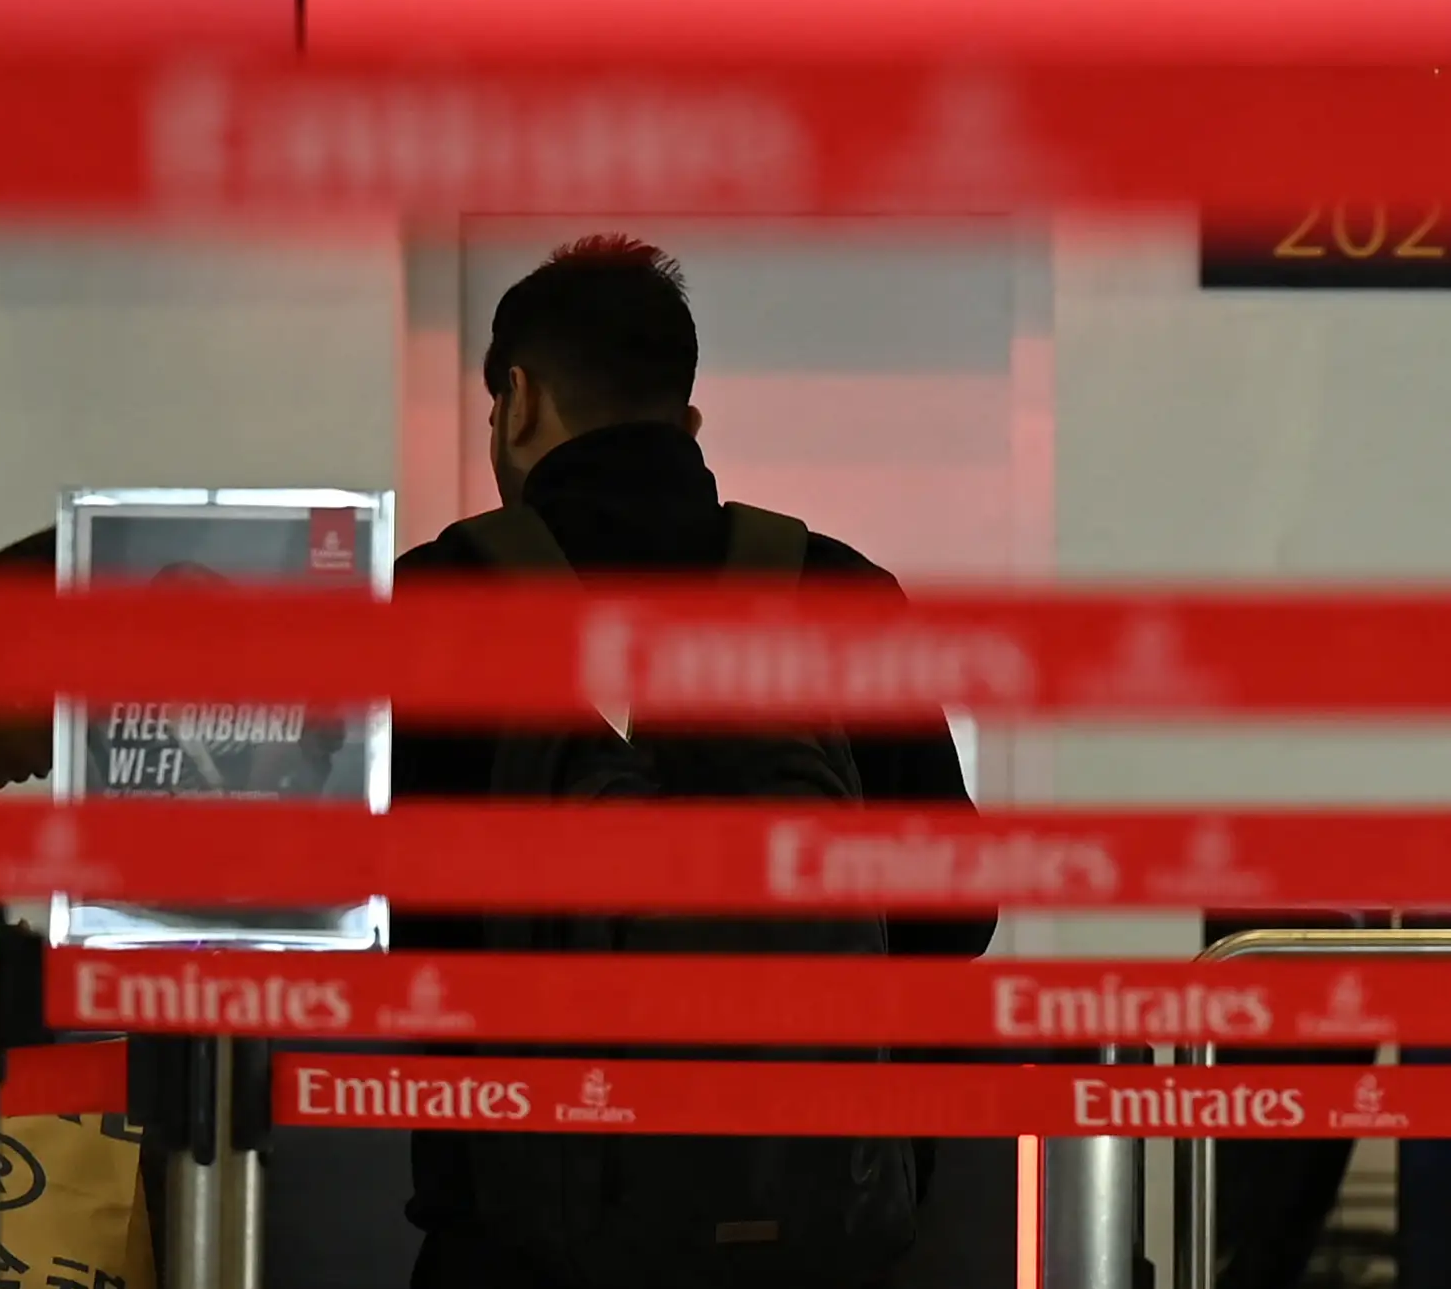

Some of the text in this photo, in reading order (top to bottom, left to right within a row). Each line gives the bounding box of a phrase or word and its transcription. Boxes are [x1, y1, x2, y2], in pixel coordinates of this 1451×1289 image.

[108, 702, 306, 742] FREE ONBOARD
[109, 746, 183, 786] WI-FI
[76, 963, 350, 1027] Emirates
[995, 976, 1272, 1037] Emirates
[297, 1068, 531, 1119] Emirates
[1073, 1077, 1305, 1127] Emirates
